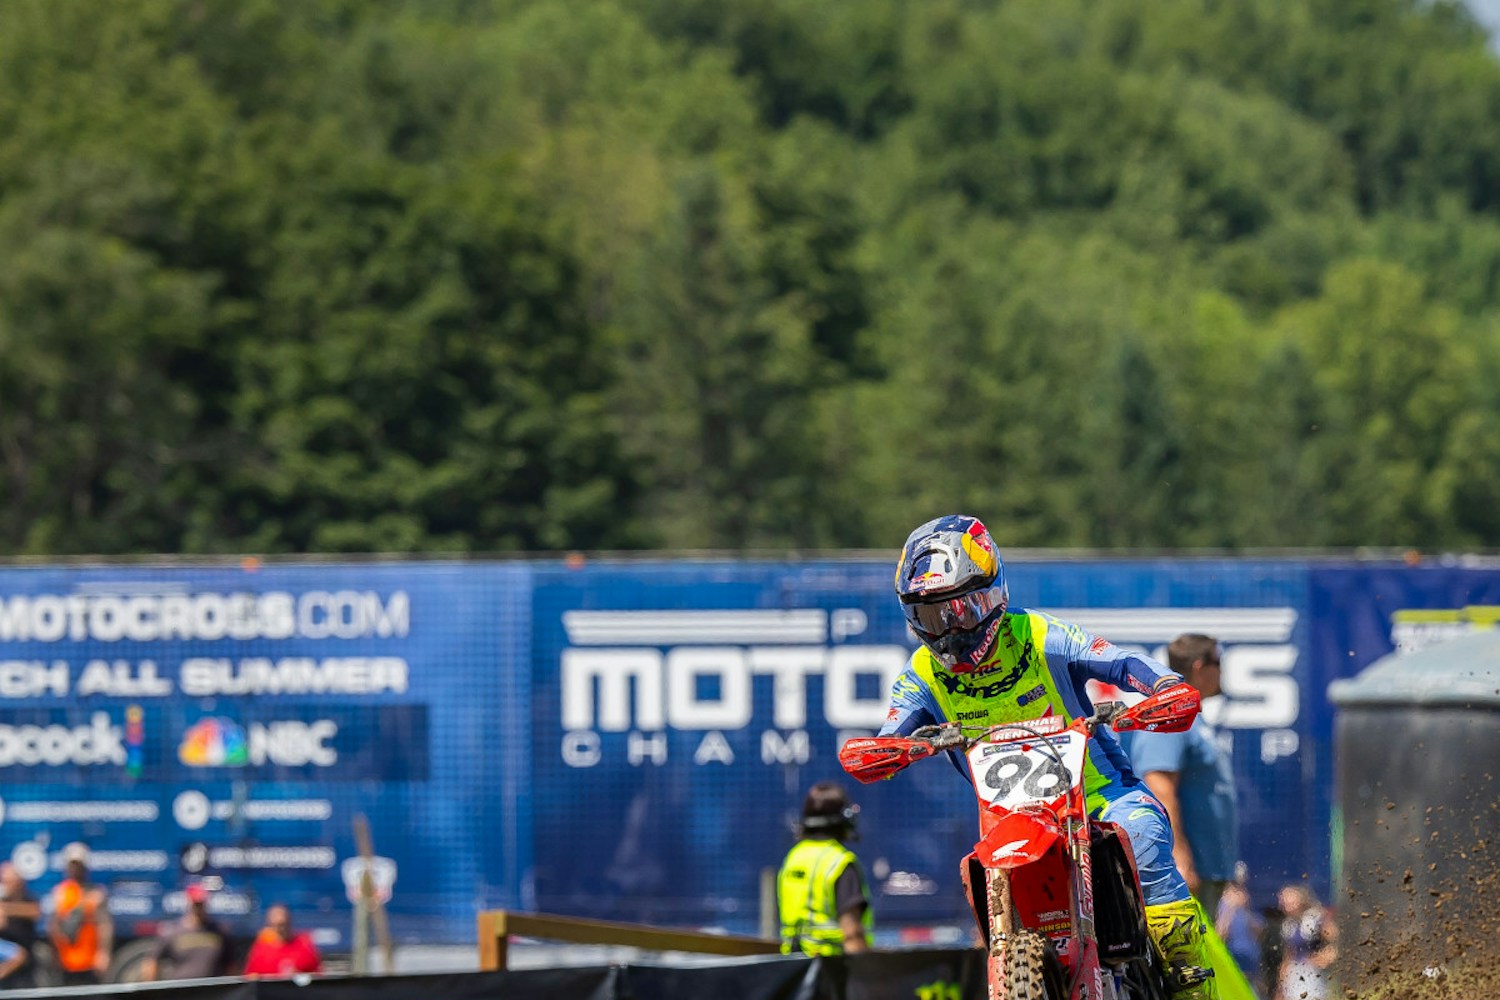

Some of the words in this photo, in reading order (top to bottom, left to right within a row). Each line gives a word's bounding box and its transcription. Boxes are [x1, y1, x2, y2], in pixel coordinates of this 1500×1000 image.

[77, 659, 173, 698] ALL
[179, 657, 410, 696] SUMMER
[1157, 687, 1190, 701] HONDA
[956, 709, 989, 721] SHOWA
[248, 718, 338, 767] NBC
[846, 740, 877, 749] HONDA
[984, 752, 1073, 806] 96
